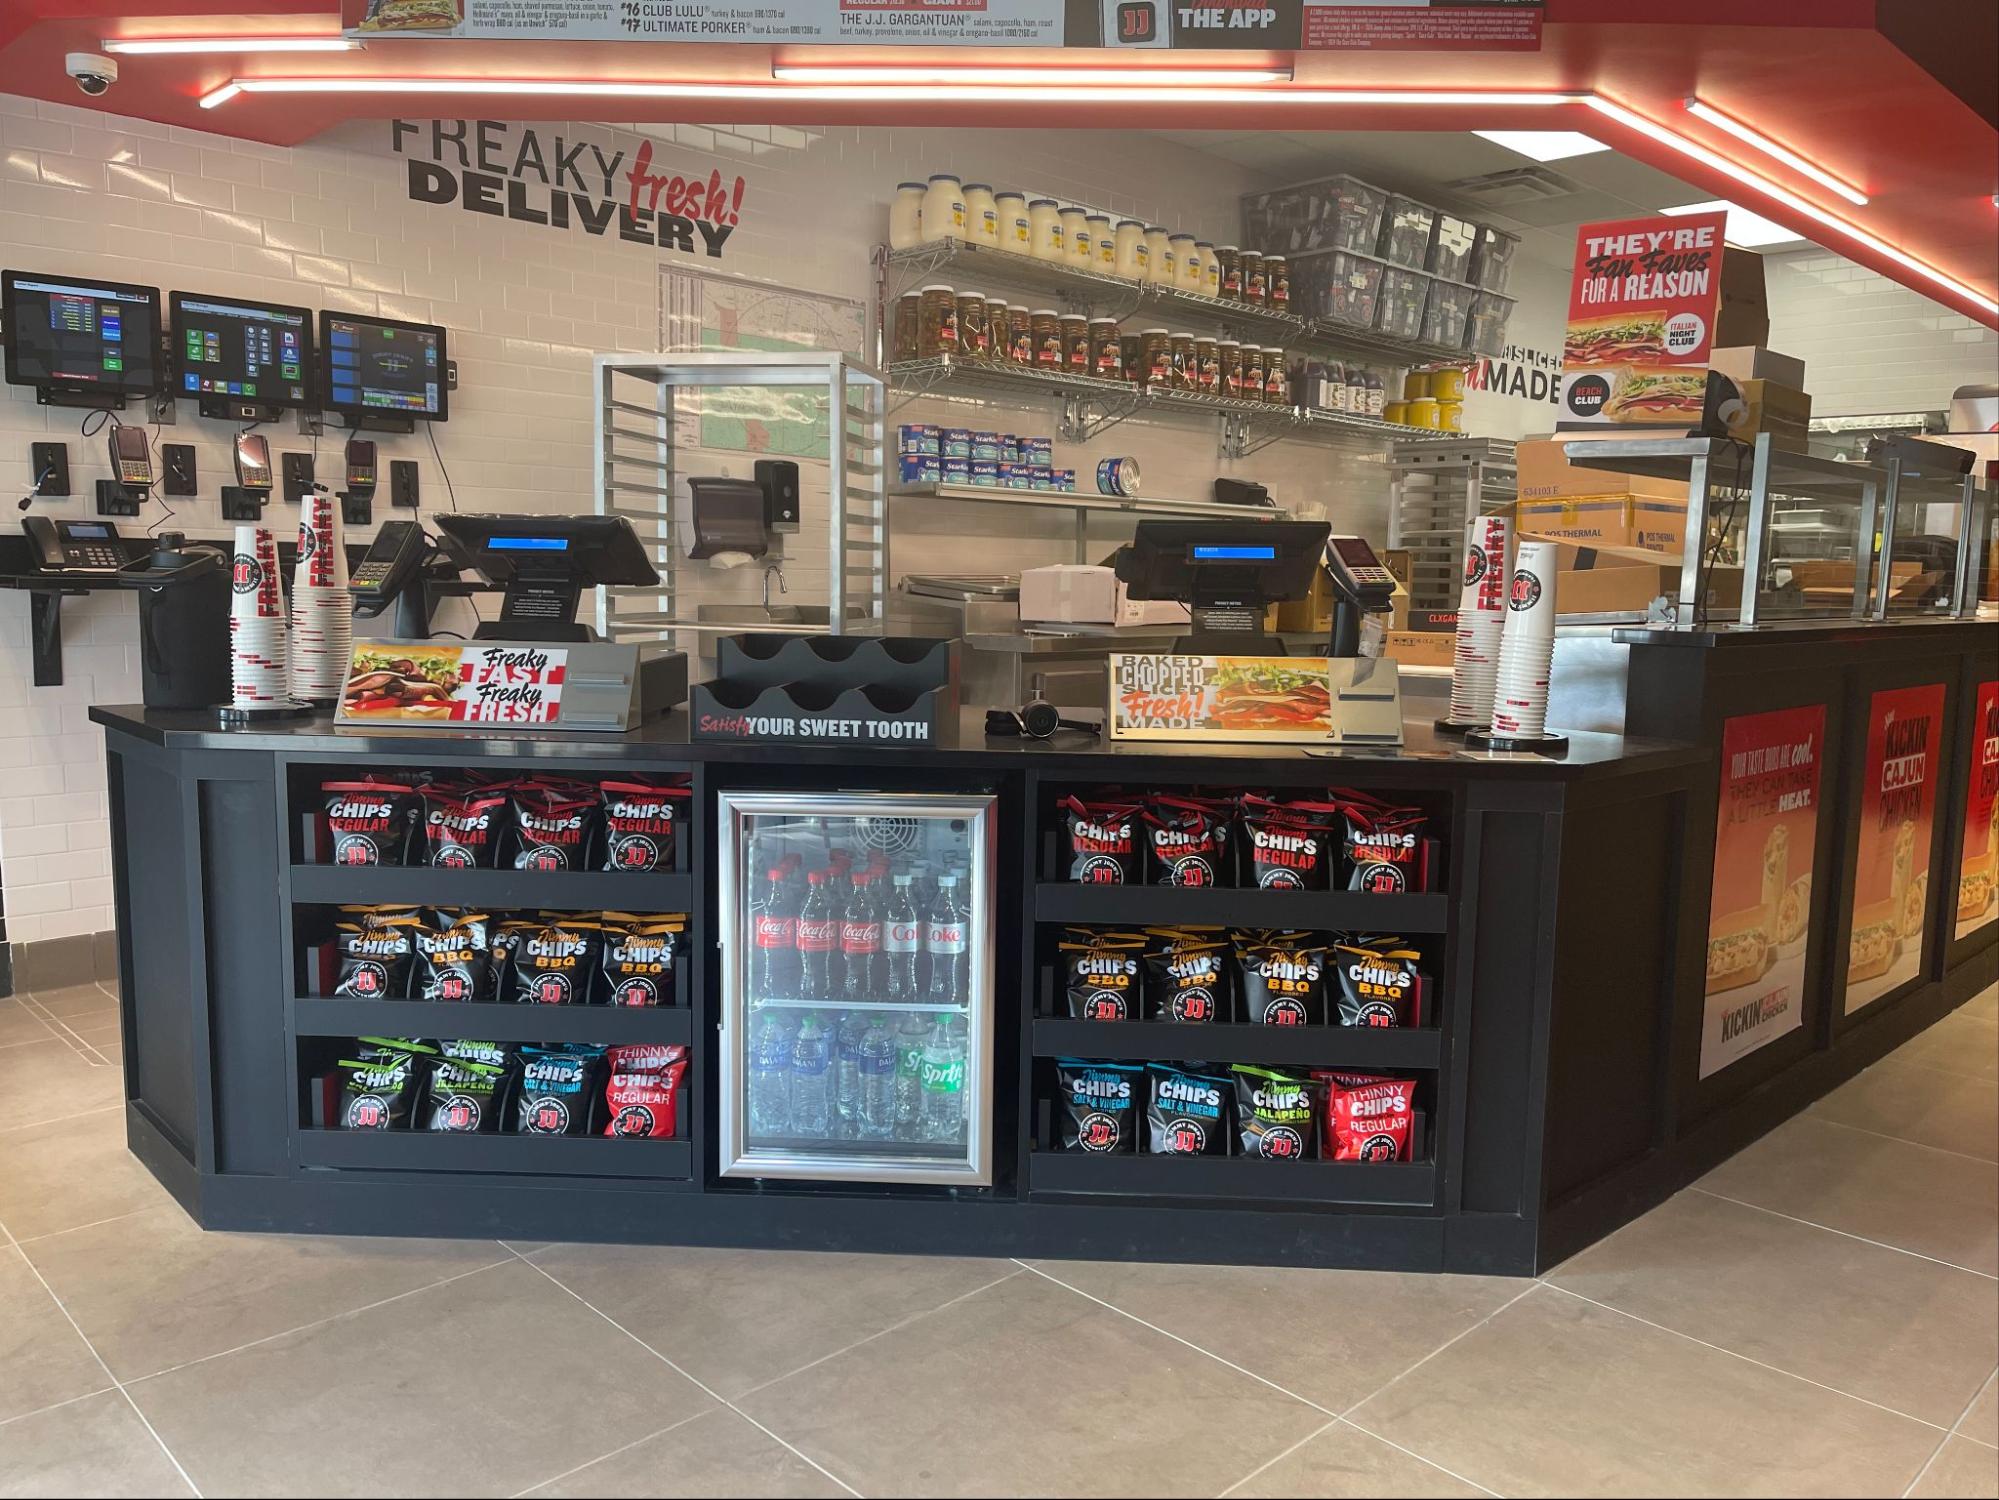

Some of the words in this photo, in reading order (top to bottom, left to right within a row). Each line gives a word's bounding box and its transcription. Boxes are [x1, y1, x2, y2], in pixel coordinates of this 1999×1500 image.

[643, 5, 672, 17] CLUB
[730, 9, 735, 18] &
[840, 13, 862, 25] THE
[865, 13, 886, 26] J.J.
[1178, 8, 1226, 28] THE
[1229, 9, 1276, 29] APP
[643, 20, 698, 33] ULTIMATE
[766, 25, 772, 34] &
[931, 28, 937, 37] &
[959, 29, 965, 37] &
[392, 119, 624, 197] FREAKY
[626, 139, 745, 226] fresh!
[408, 158, 734, 258] DELIVERY
[1585, 226, 1716, 258] THEY'RE
[1585, 254, 1634, 280] Fan
[1638, 248, 1708, 279] Faves
[1580, 276, 1608, 304] FOR
[1609, 275, 1618, 302] A
[1623, 268, 1709, 302] REASON
[1669, 330, 1696, 339] NIGHT
[1670, 321, 1697, 331] ITALIAN
[1668, 337, 1695, 347] CLUB
[1484, 359, 1561, 404] MADE
[1575, 387, 1602, 396] BEACH
[1575, 396, 1601, 405] CLUB
[1553, 486, 1559, 495] E
[309, 497, 335, 588] FREAKY
[1561, 529, 1603, 538] THERMAL
[256, 528, 280, 617] FREAKY
[1477, 518, 1504, 611] FREAKY
[482, 647, 549, 669] Freaky
[1122, 655, 1204, 667] BAKED
[1122, 666, 1204, 686] CHOPPED
[476, 682, 543, 711] Freaky
[1122, 684, 1204, 695] SLICED
[463, 701, 550, 723] FRESH
[1120, 688, 1204, 720] Fresh!
[700, 713, 750, 737] Satisfy
[746, 717, 796, 736] YOUR
[799, 718, 861, 738] SWEET
[866, 720, 928, 740] TOOTH
[1122, 716, 1205, 729] MADE
[1883, 756, 1924, 789] CAJUN
[1779, 788, 1811, 813] HEAT.
[329, 803, 393, 818] CHIPS
[613, 803, 674, 819] CHIPS
[328, 818, 390, 832] REGULAR
[429, 810, 489, 831] CHIPS
[521, 811, 582, 832] CHIPS
[610, 818, 672, 835] REGULAR
[427, 825, 488, 845] REGULAR
[1074, 821, 1132, 842] CHIPS
[1354, 830, 1416, 848] CHIPS
[1254, 831, 1318, 855] CHIPS
[1254, 847, 1317, 870] REGULAR
[1354, 844, 1414, 863] REGULAR
[349, 938, 407, 954] CHIPS
[423, 935, 487, 953] CHIPS
[527, 939, 587, 957] CHIPS
[433, 950, 474, 963] BBQ
[535, 956, 576, 968] BBQ
[613, 946, 672, 962] CHIPS
[620, 962, 662, 973] BBQ
[1077, 959, 1137, 975] CHIPS
[1167, 956, 1222, 978] CHIPS
[1259, 962, 1320, 981] CHIPS
[1349, 964, 1411, 988] CHIPS
[1087, 974, 1129, 986] BBQ
[1179, 971, 1217, 987] BBQ
[1267, 978, 1310, 993] BBQ
[1358, 982, 1402, 999] BBQ
[1721, 999, 1762, 1044] KICKIN
[617, 1046, 671, 1058] THINNY
[352, 1066, 406, 1087] CHIPS
[525, 1063, 583, 1082] CHIPS
[613, 1074, 673, 1089] CHIPS
[540, 1081, 549, 1090] &
[1073, 1079, 1131, 1098] CHIPS
[1159, 1081, 1220, 1106] CHIPS
[1350, 1084, 1405, 1102] THINNY
[613, 1092, 670, 1105] REGULAR
[1090, 1095, 1098, 1108] &
[1100, 1097, 1131, 1110] VINEGAR
[1157, 1098, 1175, 1110] SALT
[1177, 1100, 1184, 1112] &
[1186, 1102, 1219, 1117] VINEGAR
[1253, 1089, 1310, 1109] CHIPS
[1351, 1096, 1406, 1117] CHIPS
[358, 1107, 378, 1125] JJ
[449, 1107, 469, 1126] JJ
[538, 1109, 558, 1128] JJ
[1254, 1107, 1311, 1119] JALAPEÑO
[623, 1114, 644, 1133] JJ
[1351, 1118, 1407, 1133] REGULAR
